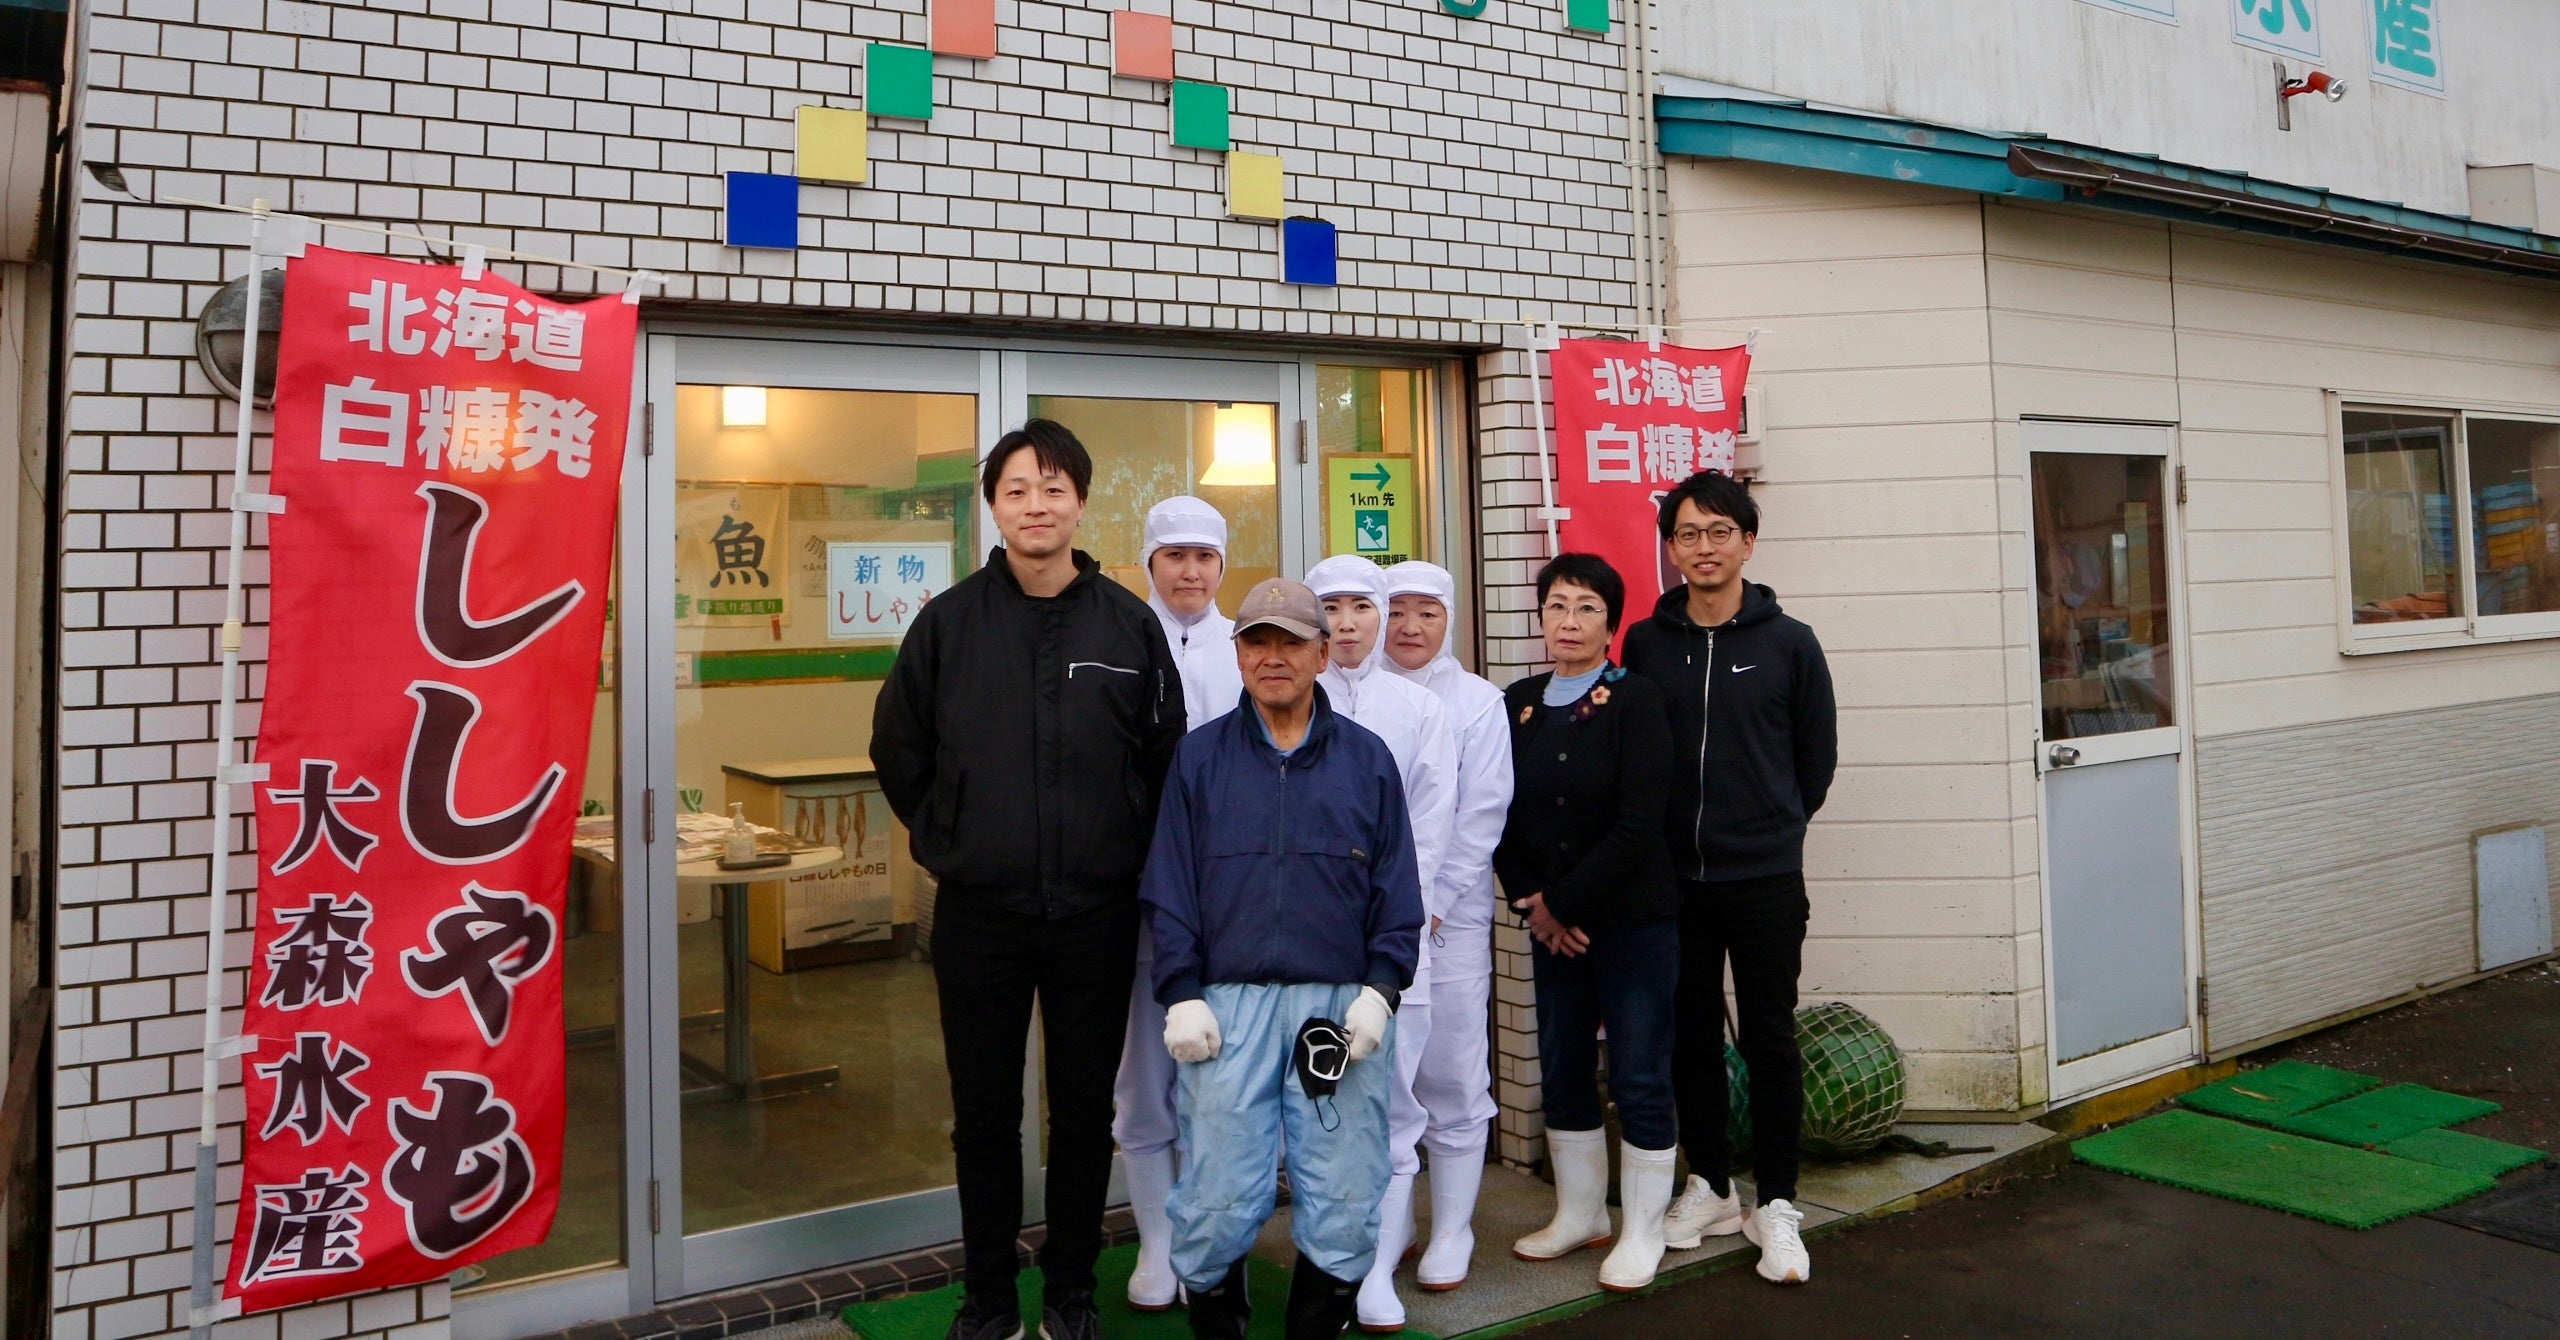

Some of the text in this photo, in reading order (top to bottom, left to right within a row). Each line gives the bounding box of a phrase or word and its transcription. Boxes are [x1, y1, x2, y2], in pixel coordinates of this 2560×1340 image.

[348, 279, 587, 372] 北海道
[1592, 357, 1727, 412] 北海道
[319, 376, 599, 479] 白糠発
[1350, 492, 1379, 506] 1km
[708, 514, 769, 589] 魚
[854, 554, 925, 584] 新物
[239, 758, 381, 1289] 大森水産
